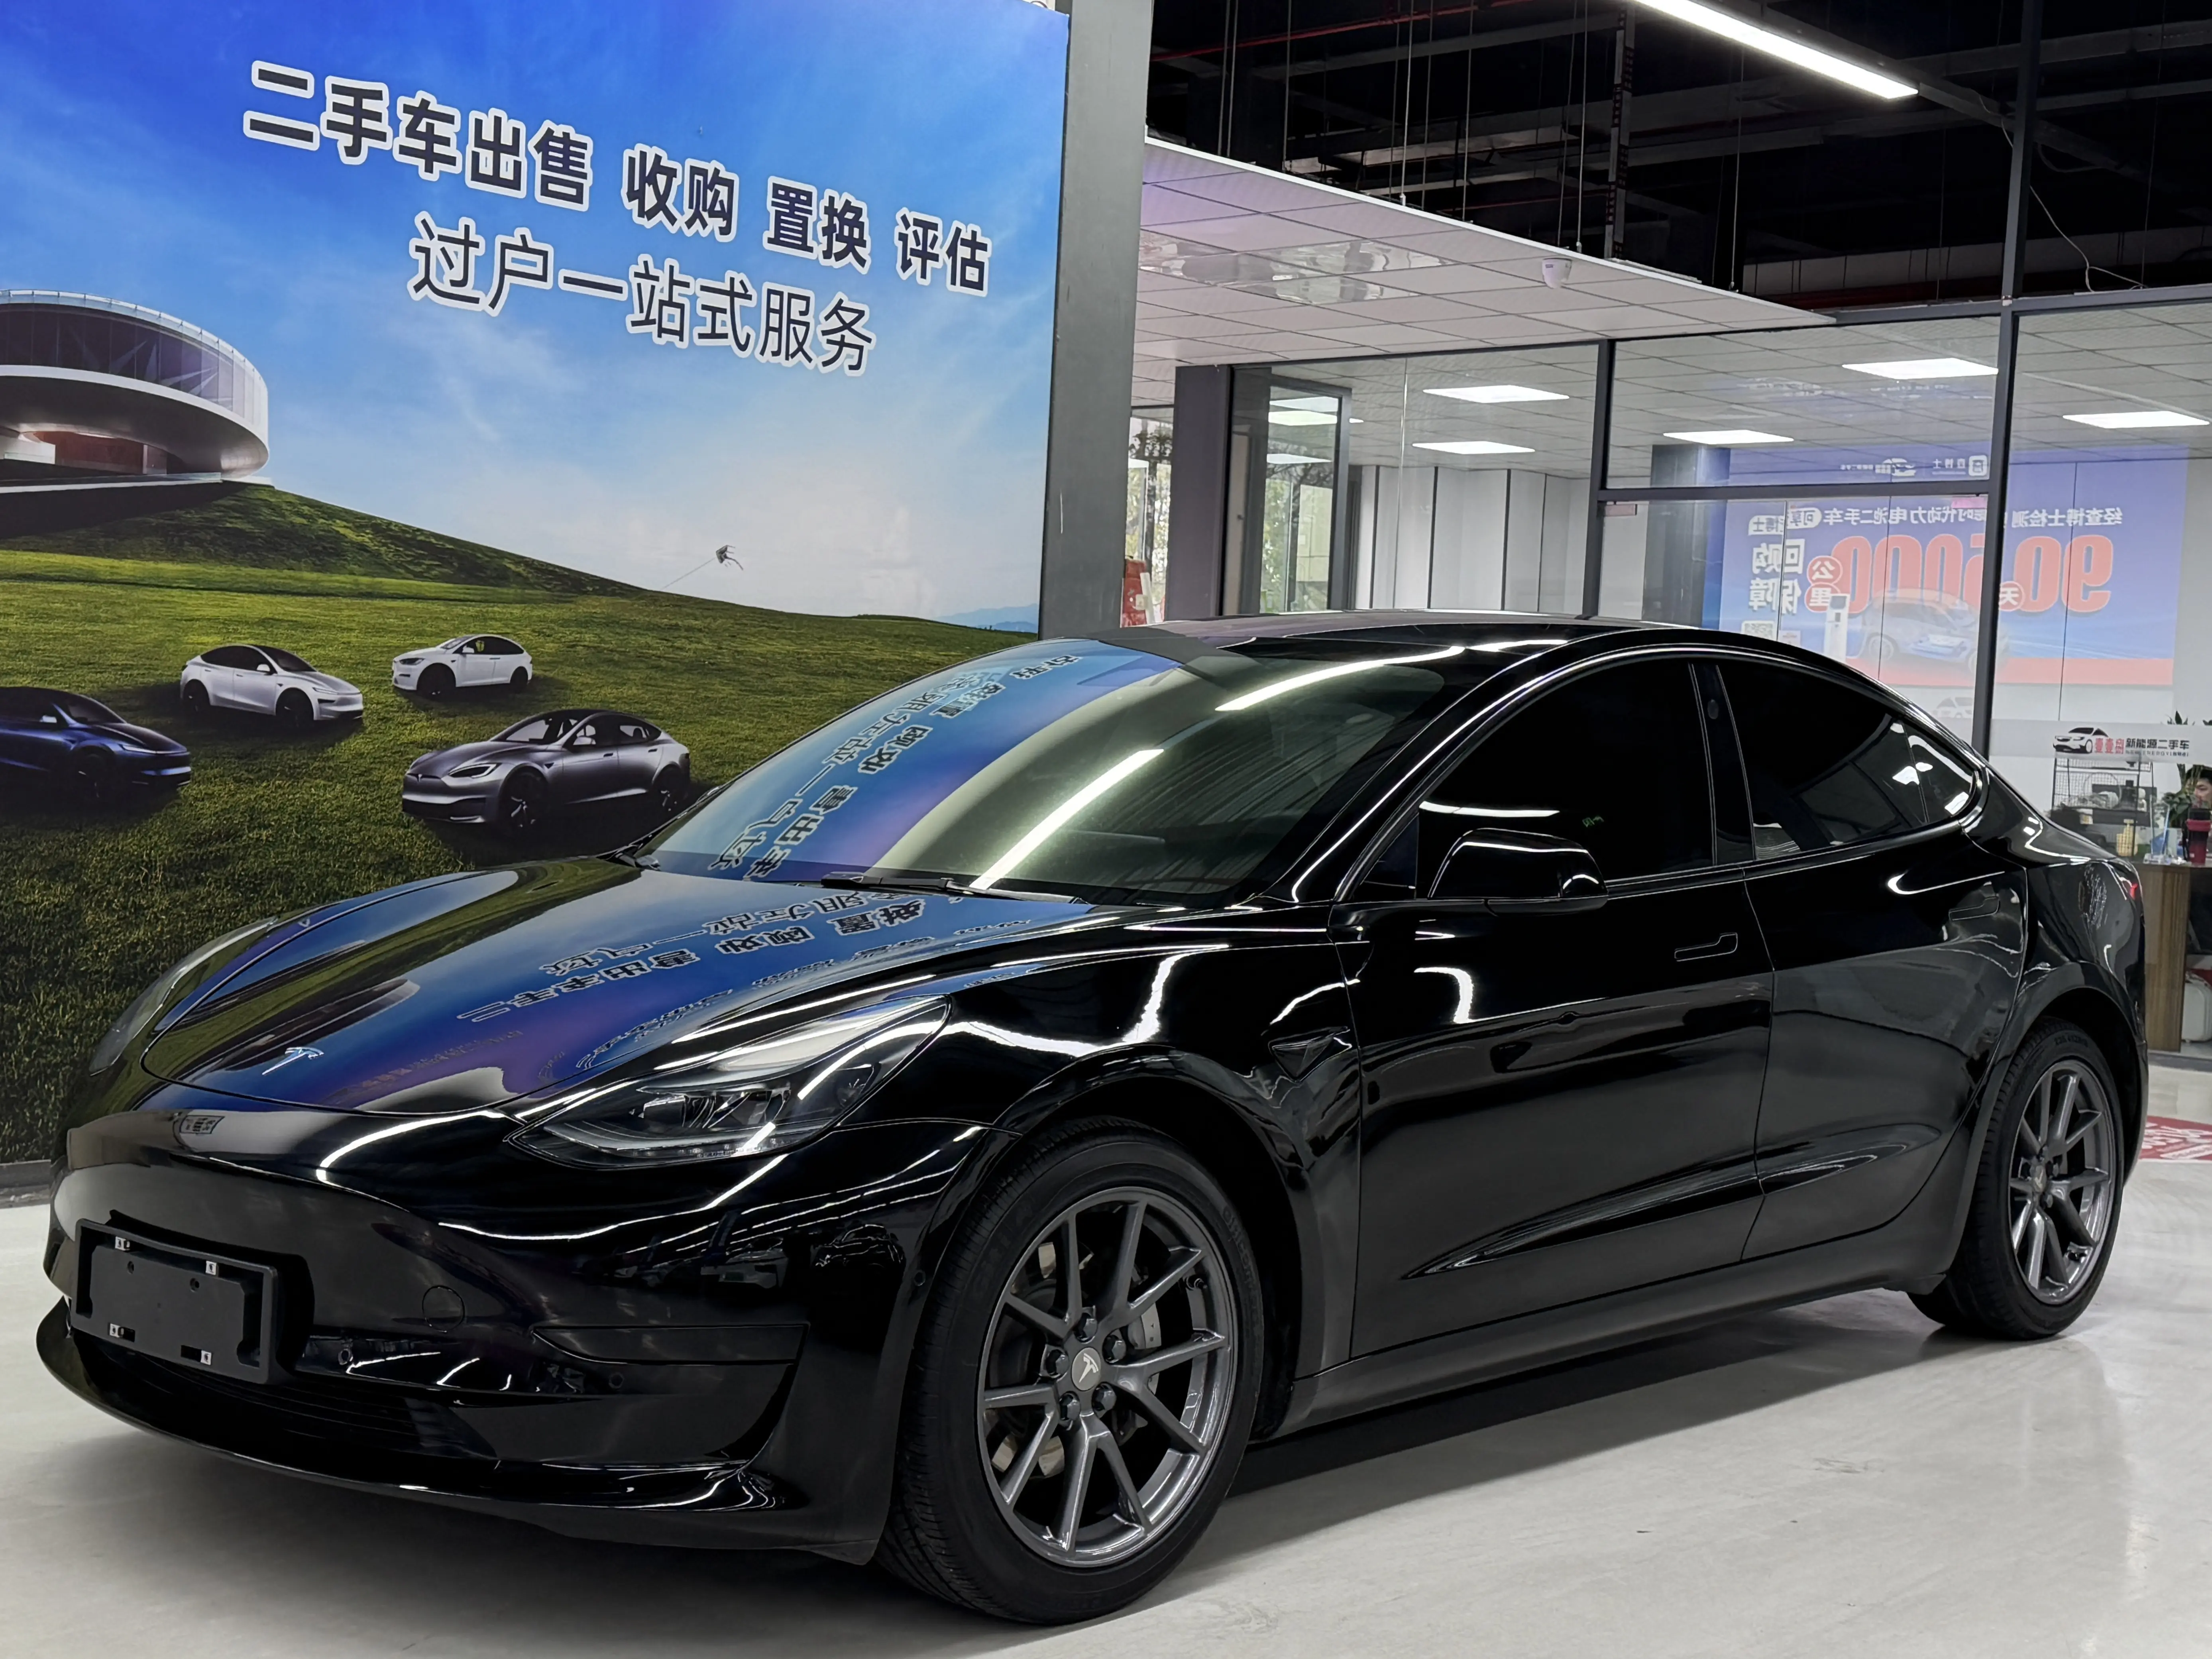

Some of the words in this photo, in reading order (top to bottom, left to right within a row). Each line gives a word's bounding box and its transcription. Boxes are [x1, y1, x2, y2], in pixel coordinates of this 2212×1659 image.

[243, 60, 593, 211] 二手车出售
[622, 144, 739, 241] 收购
[764, 176, 868, 273] 置换
[895, 207, 992, 296] 评估
[408, 211, 875, 375] 过户一站式服务
[2126, 738, 2189, 750] 新能源二手车
